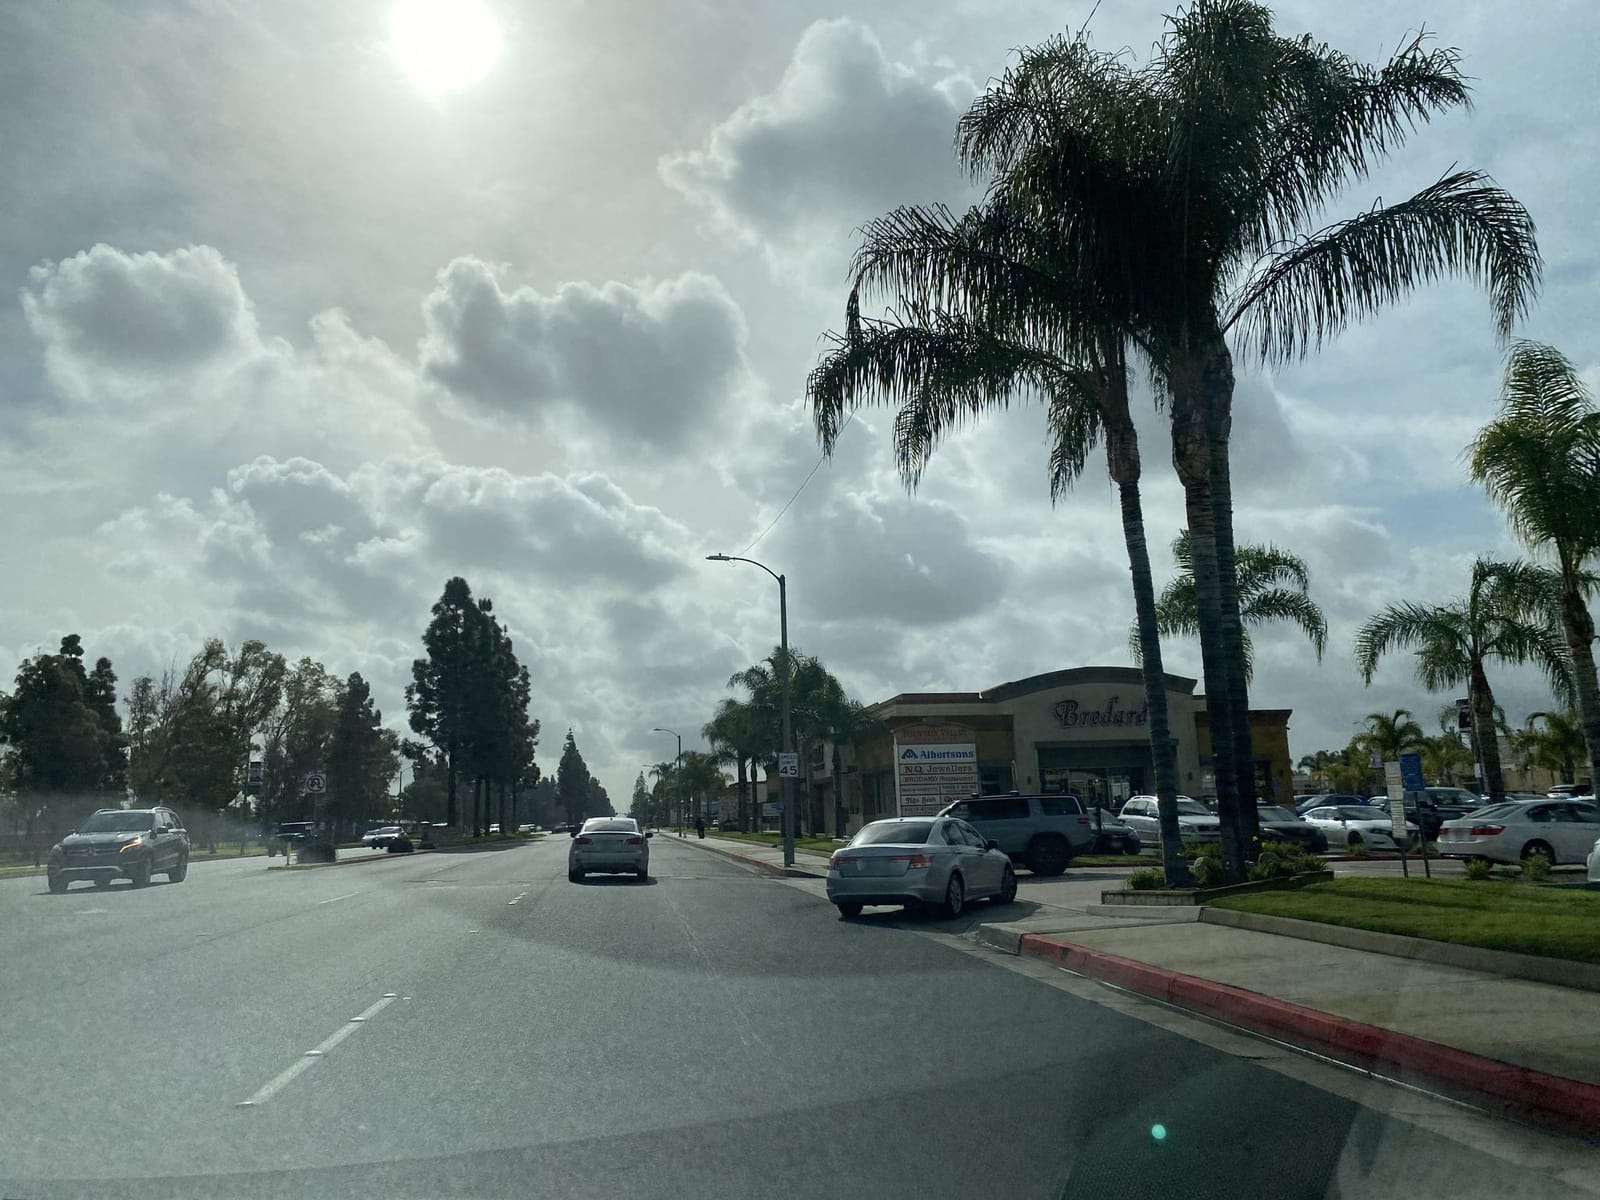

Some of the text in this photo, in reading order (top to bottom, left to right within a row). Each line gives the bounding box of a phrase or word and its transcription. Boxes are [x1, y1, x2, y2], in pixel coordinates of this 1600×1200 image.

[1055, 696, 1147, 728] Brodard
[920, 750, 974, 759] Albertsons
[780, 765, 797, 776] 45
[926, 765, 973, 773] Jewellers
